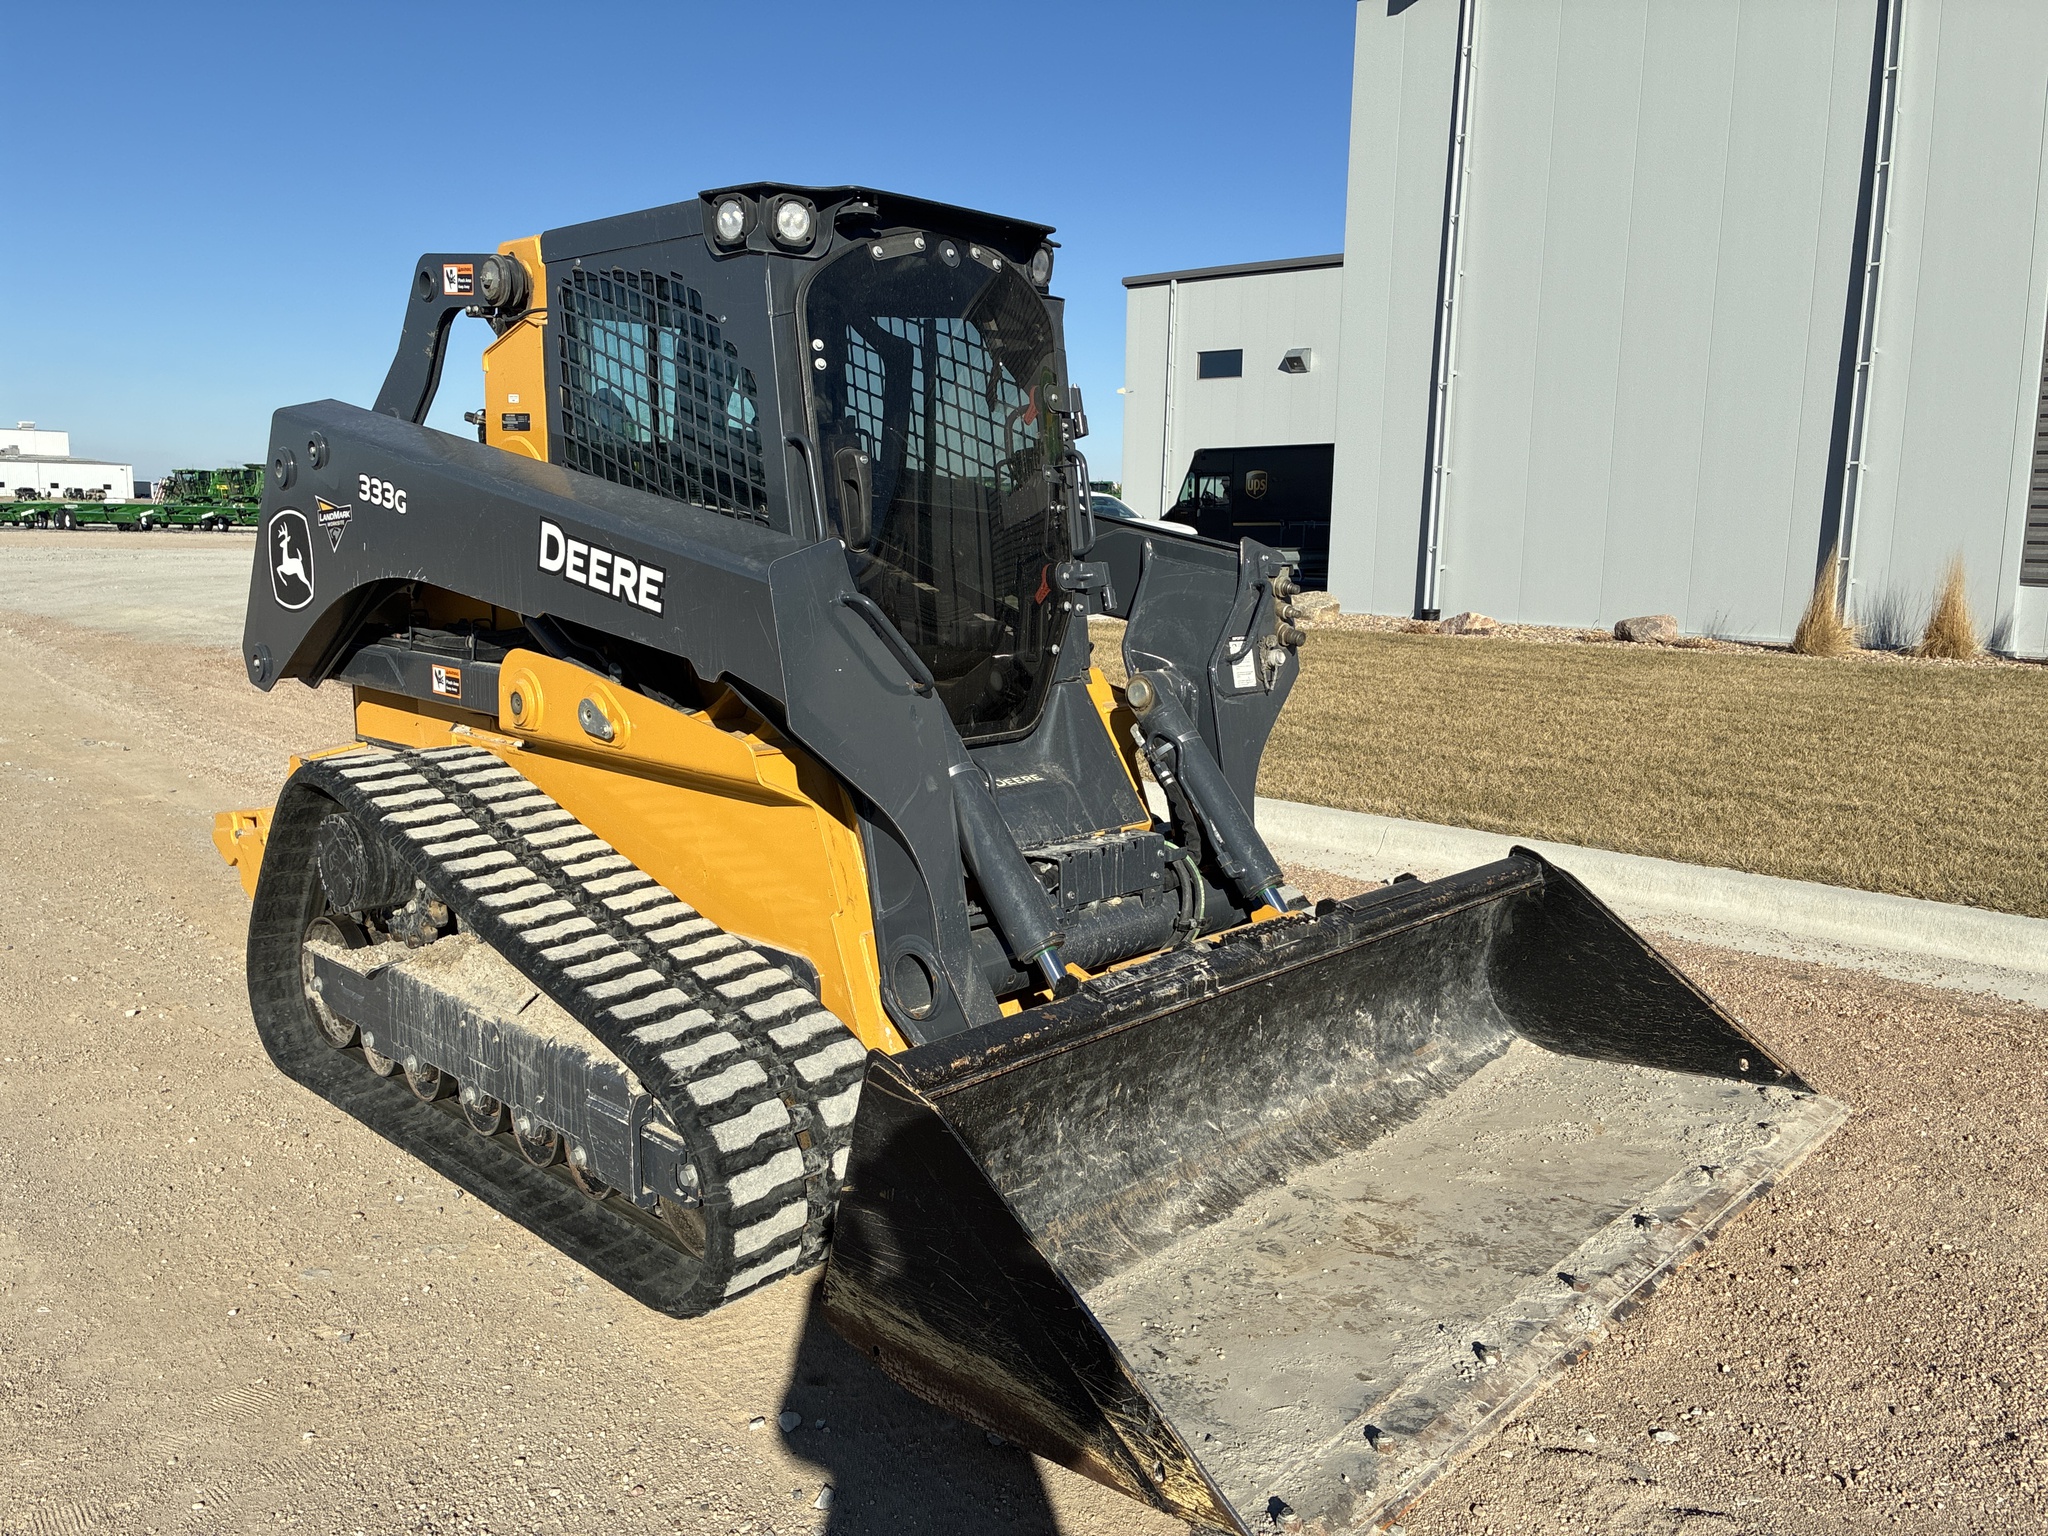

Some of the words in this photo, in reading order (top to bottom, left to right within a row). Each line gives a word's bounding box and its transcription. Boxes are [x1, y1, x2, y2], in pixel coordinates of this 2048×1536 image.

[359, 473, 407, 515] 333G
[1247, 478, 1266, 495] ups
[319, 510, 351, 522] LANDMARK
[539, 520, 664, 614] DEERE
